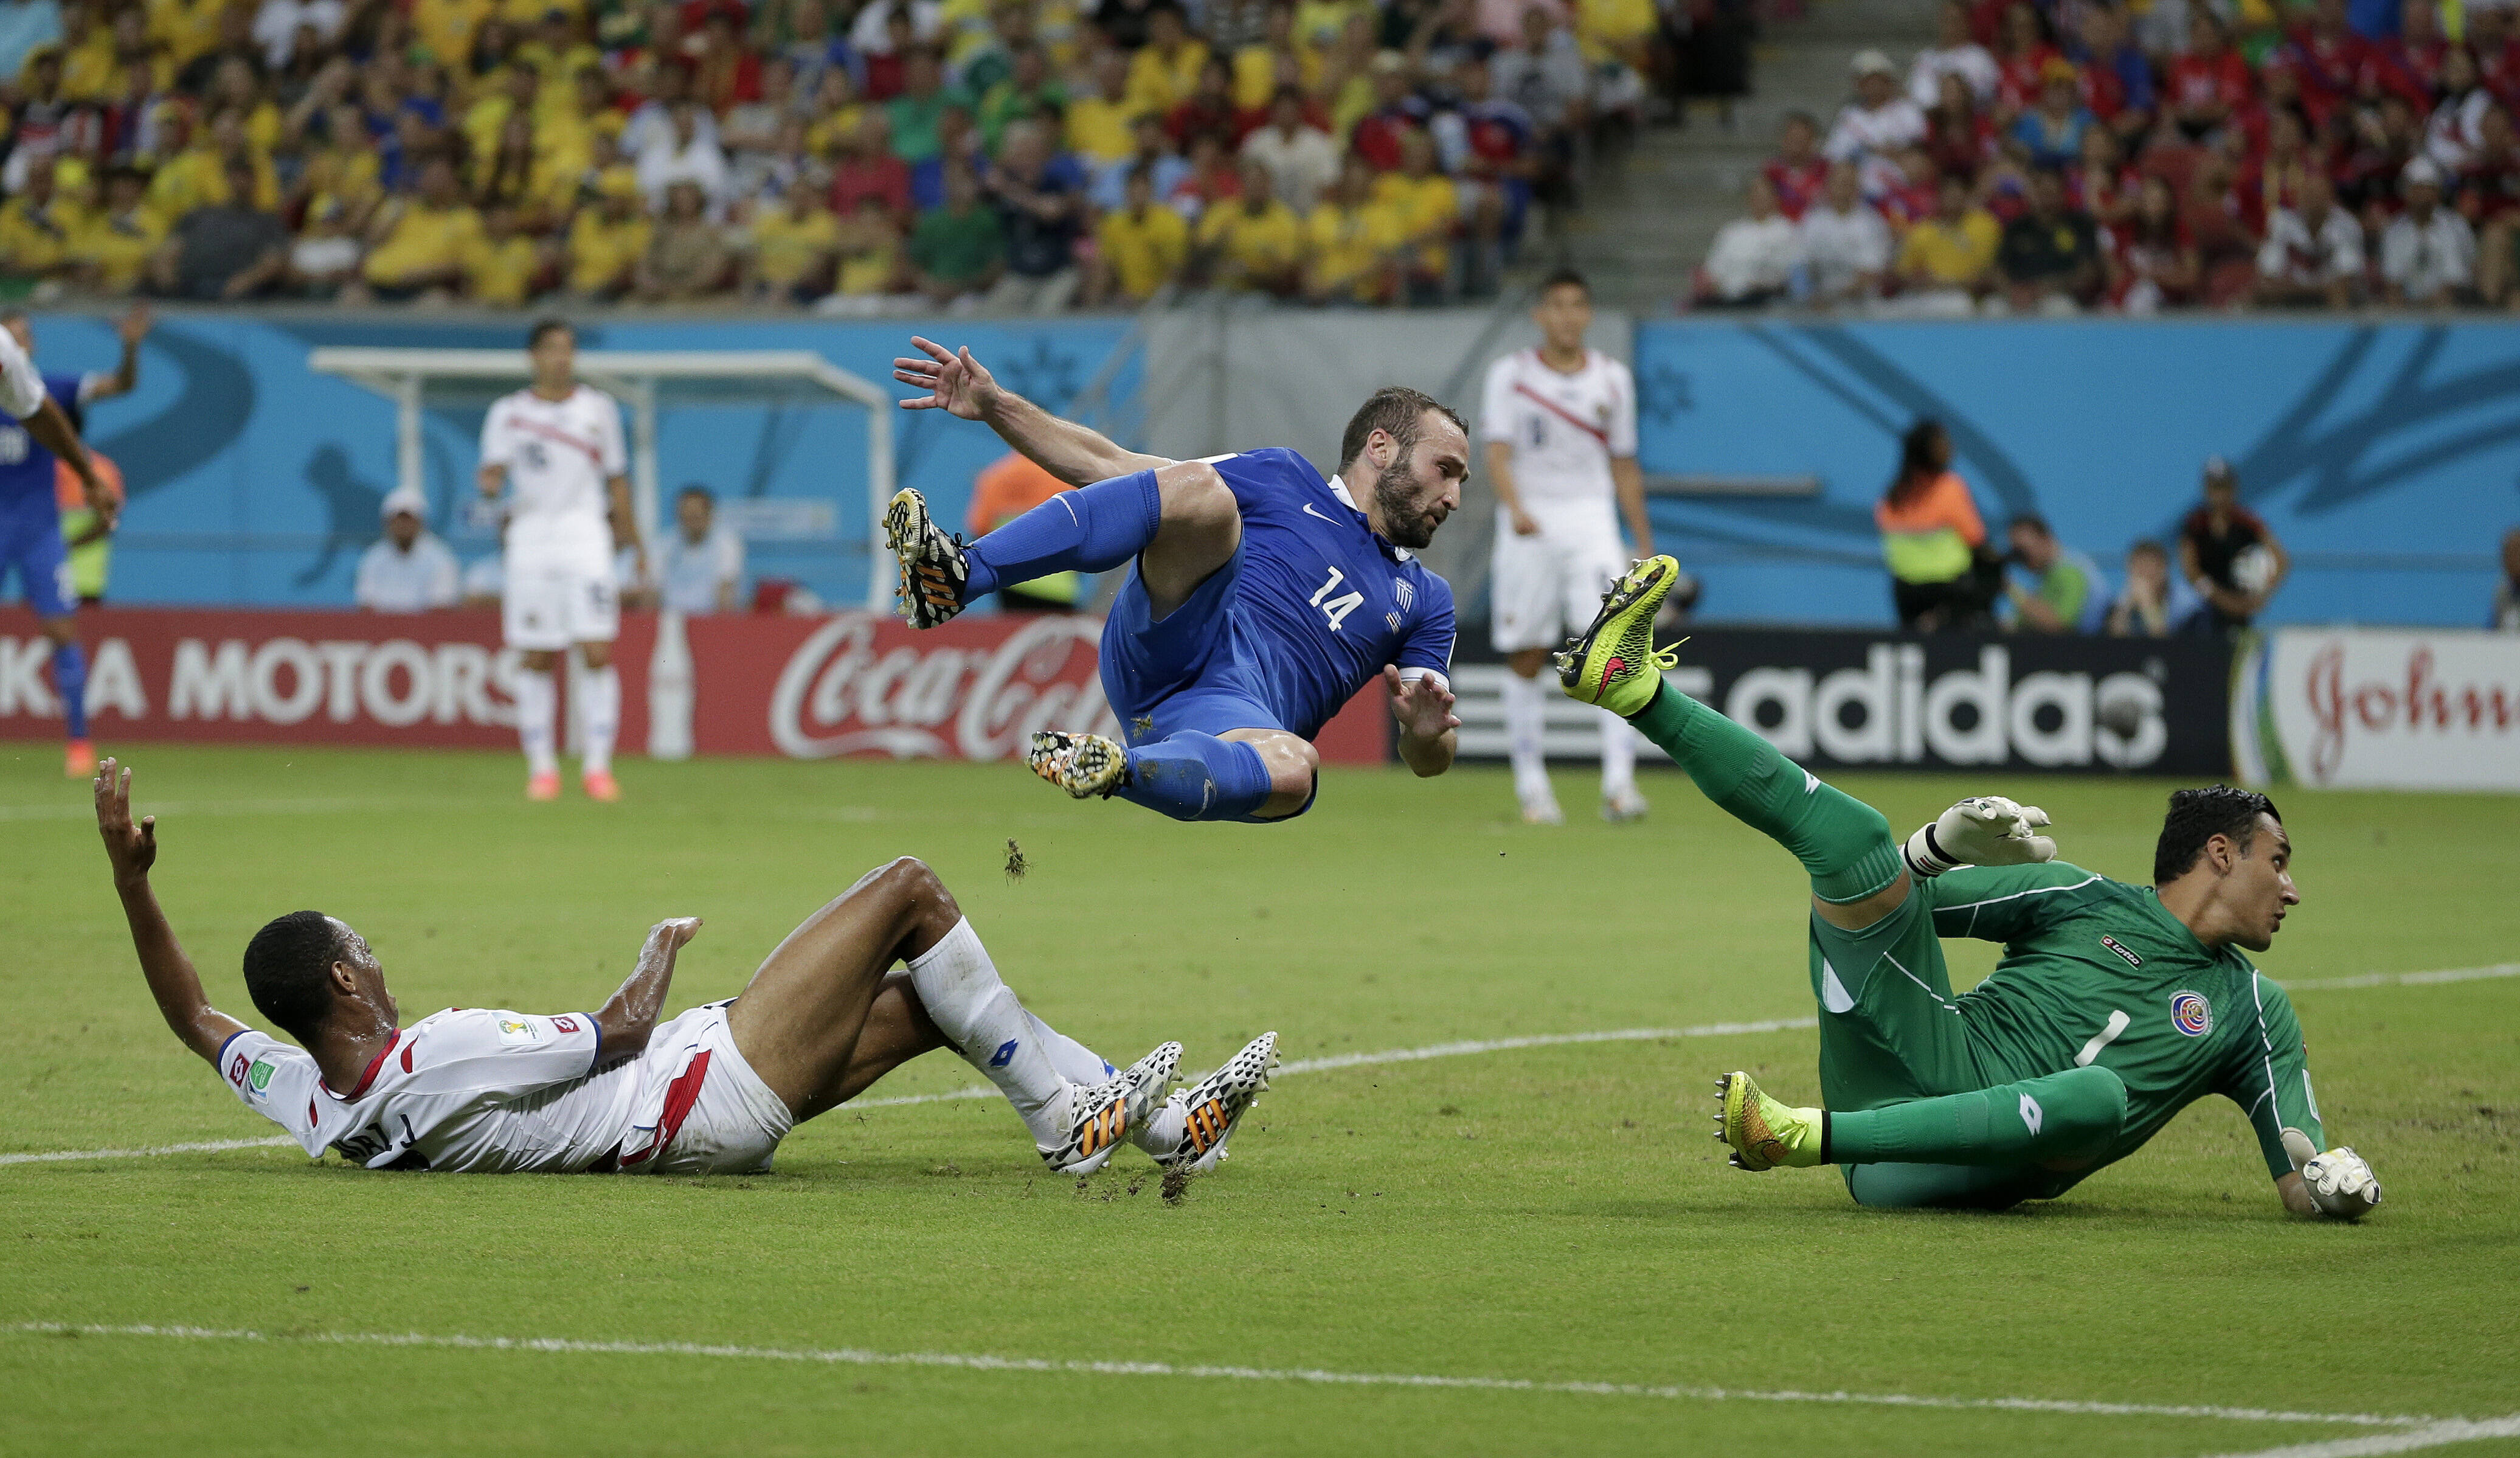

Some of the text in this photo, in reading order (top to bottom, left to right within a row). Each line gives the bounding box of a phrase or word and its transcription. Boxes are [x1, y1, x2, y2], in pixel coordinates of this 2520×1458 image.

[1309, 565, 1365, 632] 14
[0, 635, 148, 720] KA
[769, 611, 1124, 760] Coca-Col
[1725, 642, 2168, 769] adidas
[2305, 640, 2520, 783] John
[2073, 1009, 2131, 1067] 1
